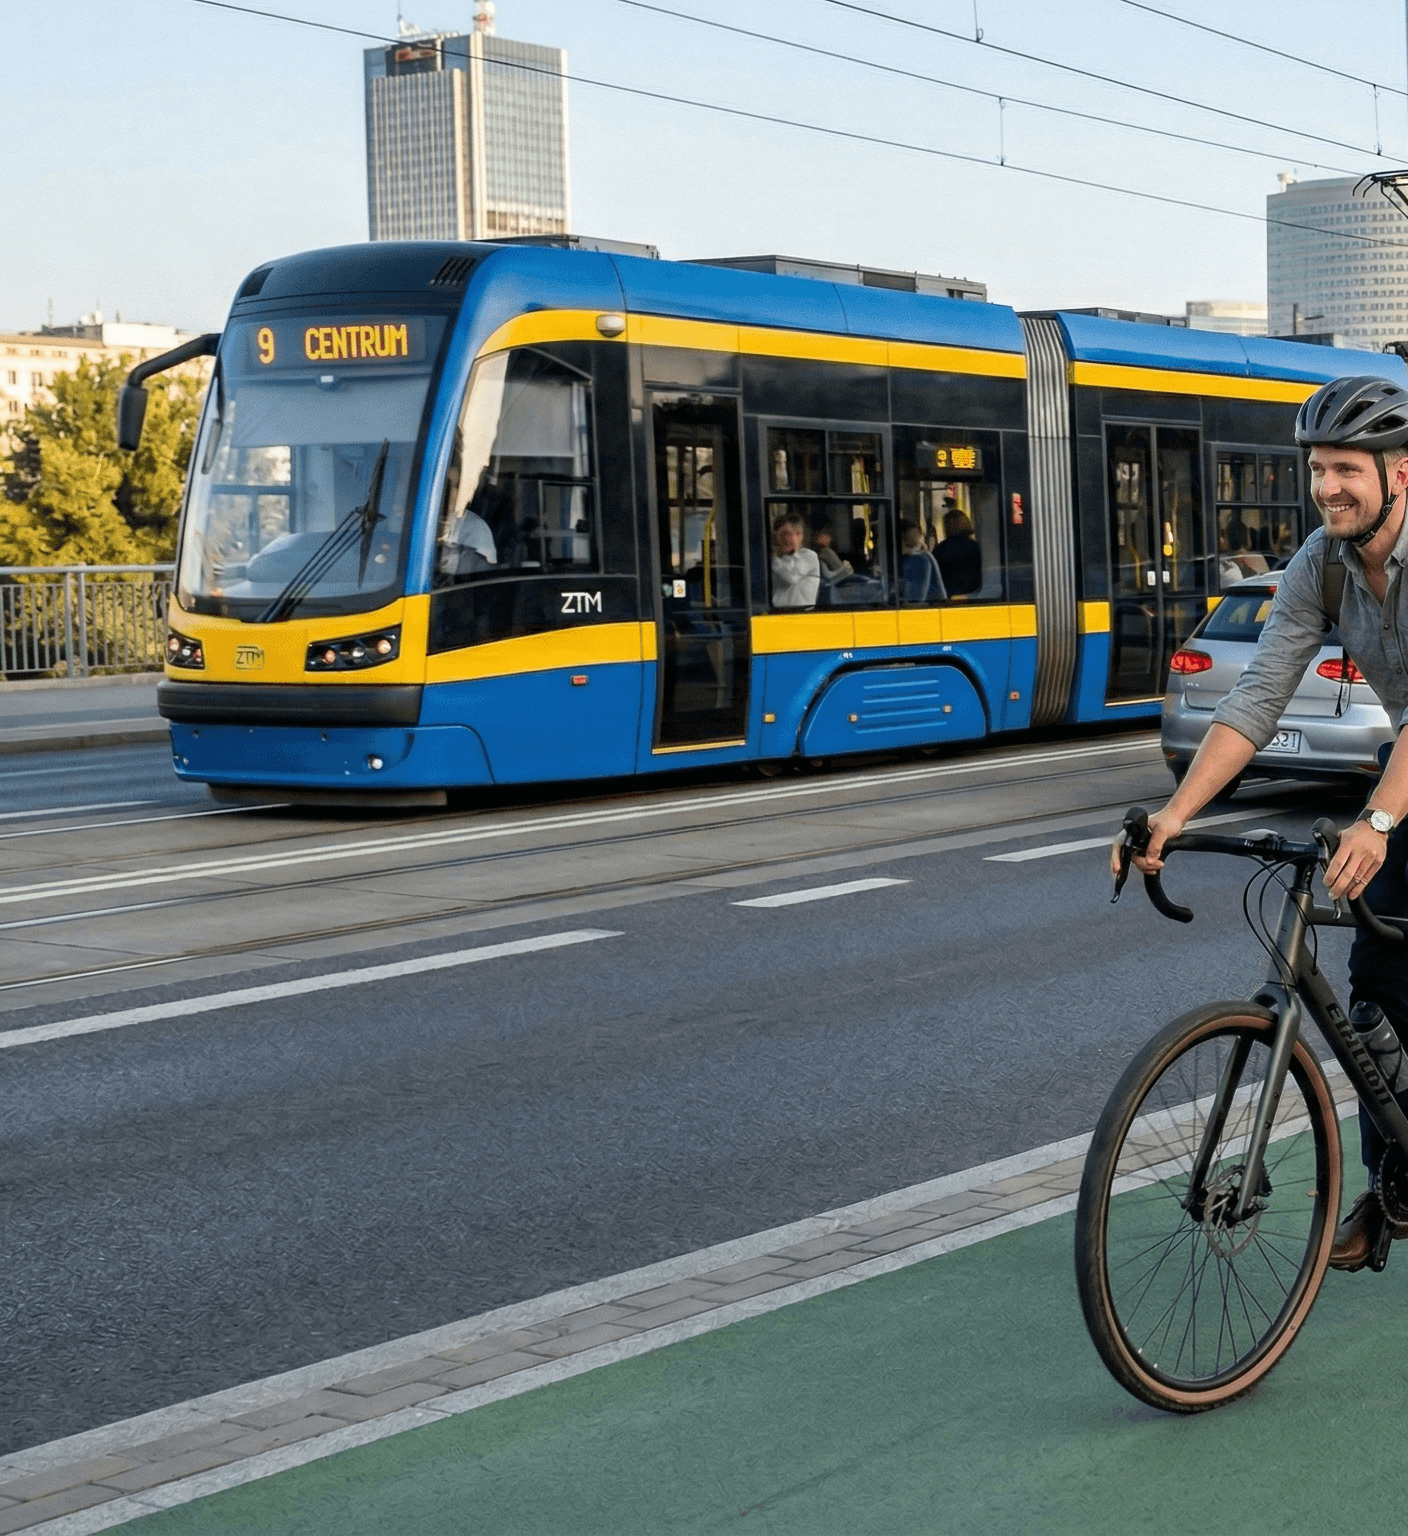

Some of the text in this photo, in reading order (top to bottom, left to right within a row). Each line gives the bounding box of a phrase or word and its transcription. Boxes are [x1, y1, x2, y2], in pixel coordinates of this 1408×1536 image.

[257, 323, 408, 364] 9 CENTRUM
[561, 591, 602, 613] ZTM
[236, 650, 265, 667] ZTM
